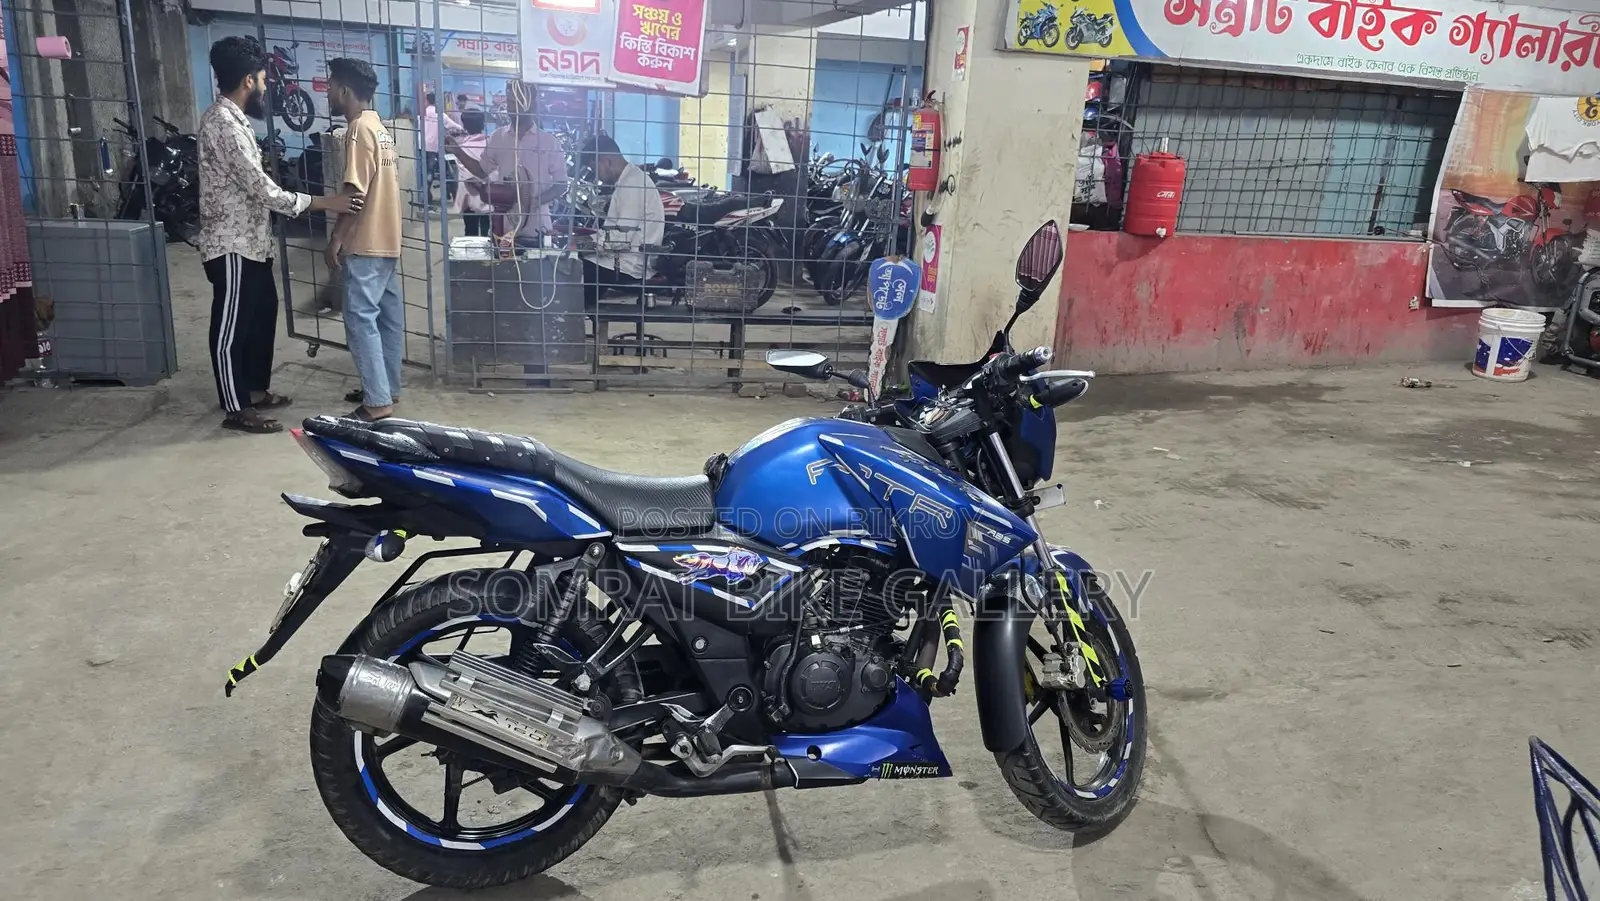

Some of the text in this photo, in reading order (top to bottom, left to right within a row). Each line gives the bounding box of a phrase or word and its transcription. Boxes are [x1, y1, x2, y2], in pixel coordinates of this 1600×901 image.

[672, 12, 683, 26] ও
[1308, 0, 1443, 52] বাইক
[654, 37, 696, 61] বিকাশ
[538, 48, 600, 75] নগদ
[637, 52, 674, 72] করুন
[986, 529, 1012, 545] ABS
